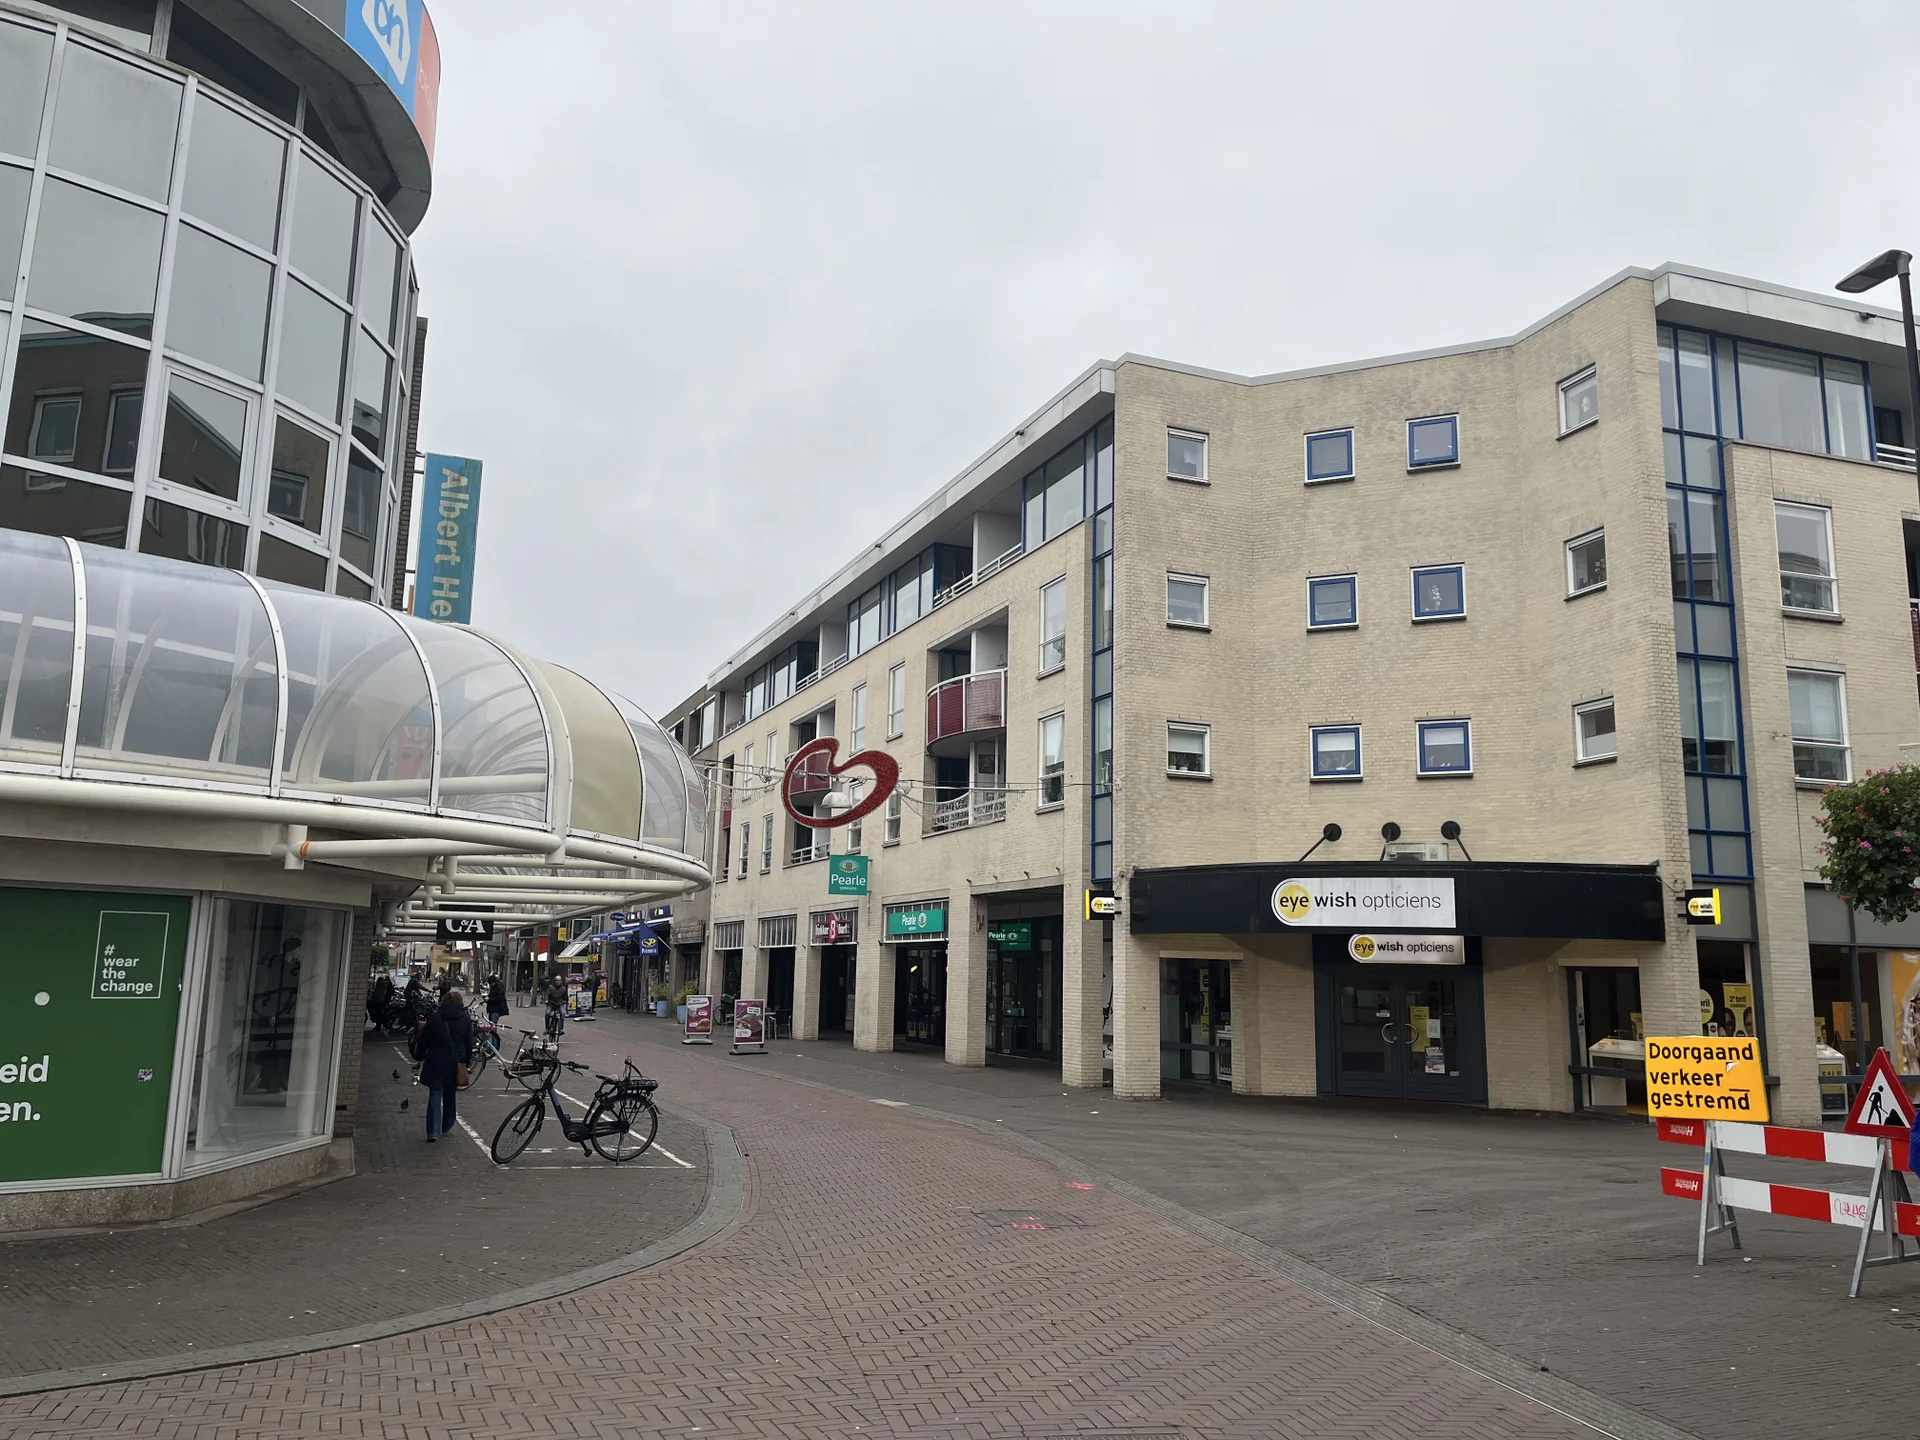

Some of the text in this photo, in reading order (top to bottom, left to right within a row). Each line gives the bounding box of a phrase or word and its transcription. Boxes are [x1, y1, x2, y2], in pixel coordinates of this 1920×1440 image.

[430, 468, 469, 624] Albert He
[831, 874, 866, 886] Pearle
[1279, 891, 1441, 912] eye wish opticiens
[445, 918, 487, 933] C&A
[901, 914, 917, 926] Pearle
[988, 931, 1006, 939] Pearle
[104, 944, 115, 955] #
[1354, 941, 1454, 954] eye wish opticiens
[103, 957, 139, 967] wear
[102, 968, 126, 979] the
[100, 980, 153, 994] change
[1649, 1042, 1754, 1064] Doorgaand
[0, 1055, 50, 1083] eid
[1649, 1068, 1724, 1087] verkeer
[1651, 1090, 1750, 1110] gestremd
